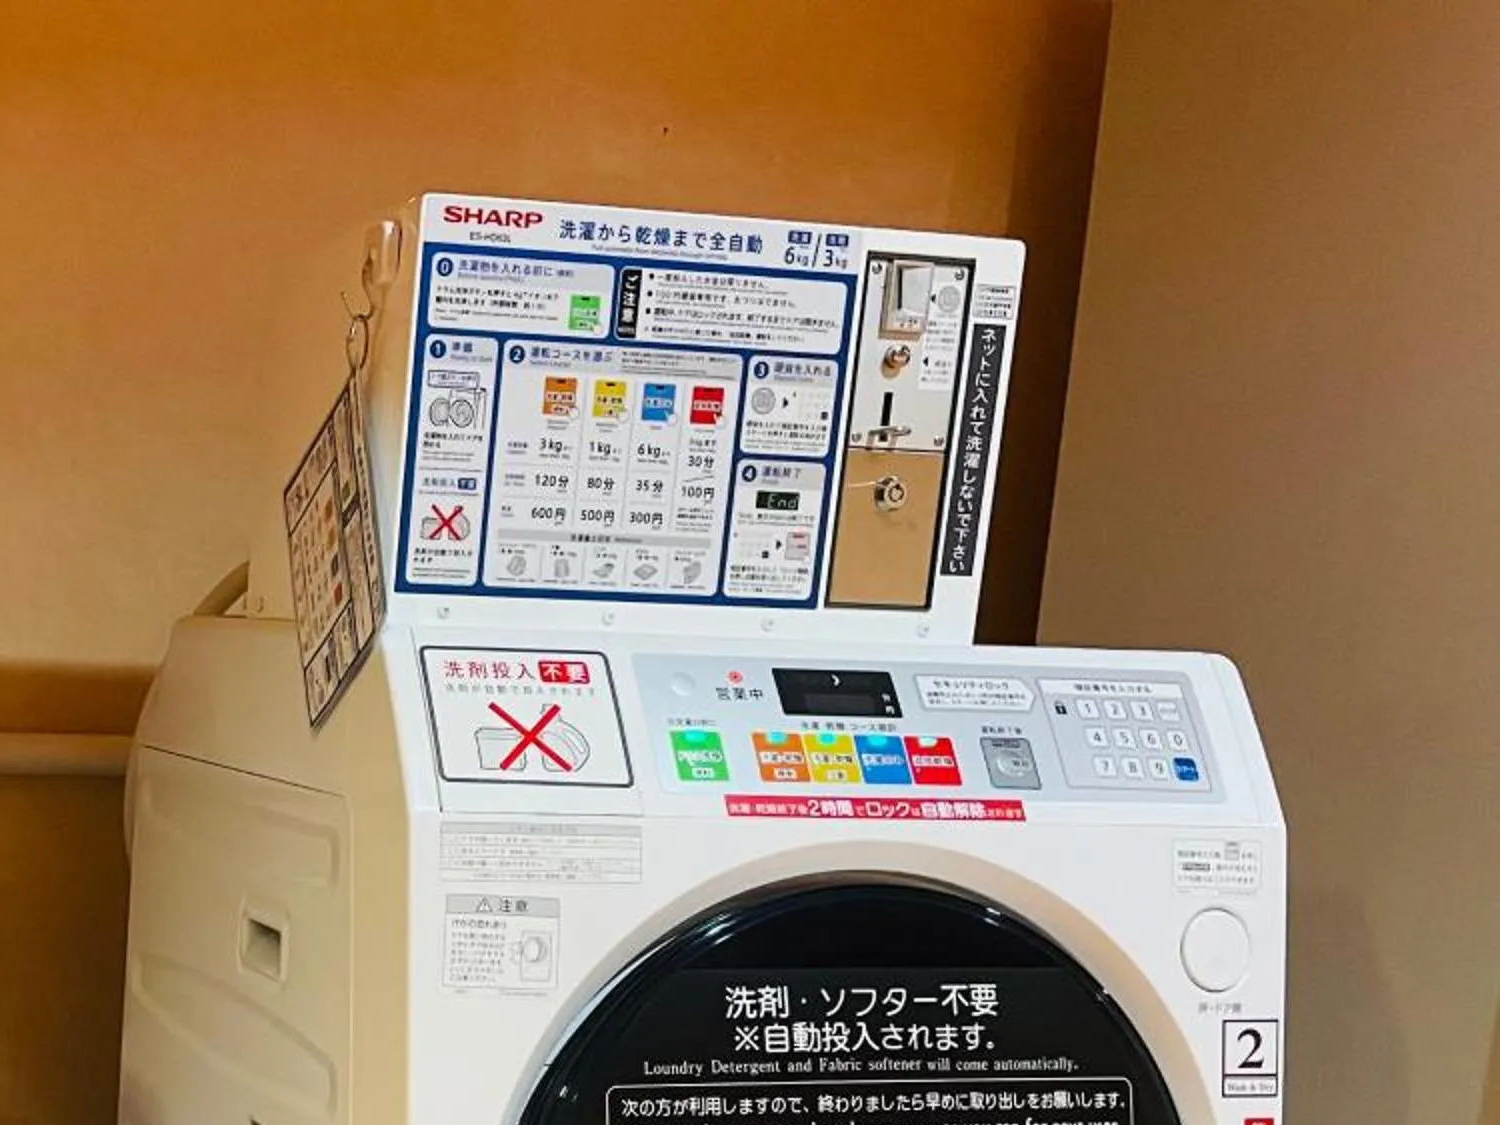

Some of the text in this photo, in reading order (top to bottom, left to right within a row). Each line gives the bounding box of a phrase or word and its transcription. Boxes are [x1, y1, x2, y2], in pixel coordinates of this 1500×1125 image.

[443, 205, 543, 229] SHARP
[559, 219, 763, 254] 洗濯から乾燥まで全自動
[950, 328, 998, 573] ネットに入れて洗濯しないで下さい
[444, 660, 587, 682] 洗剤投入 不要
[725, 984, 999, 1019] 洗剤・ソフター不要
[734, 1021, 995, 1053] ※自動投入されます。
[1237, 1028, 1264, 1069] 2
[644, 1057, 1079, 1076] Loundry Detergent and Fabric softener will come automatically.
[621, 1091, 1126, 1118] 次の方が利用しますので、終わりましたら早めに取り出しをお願いします。
